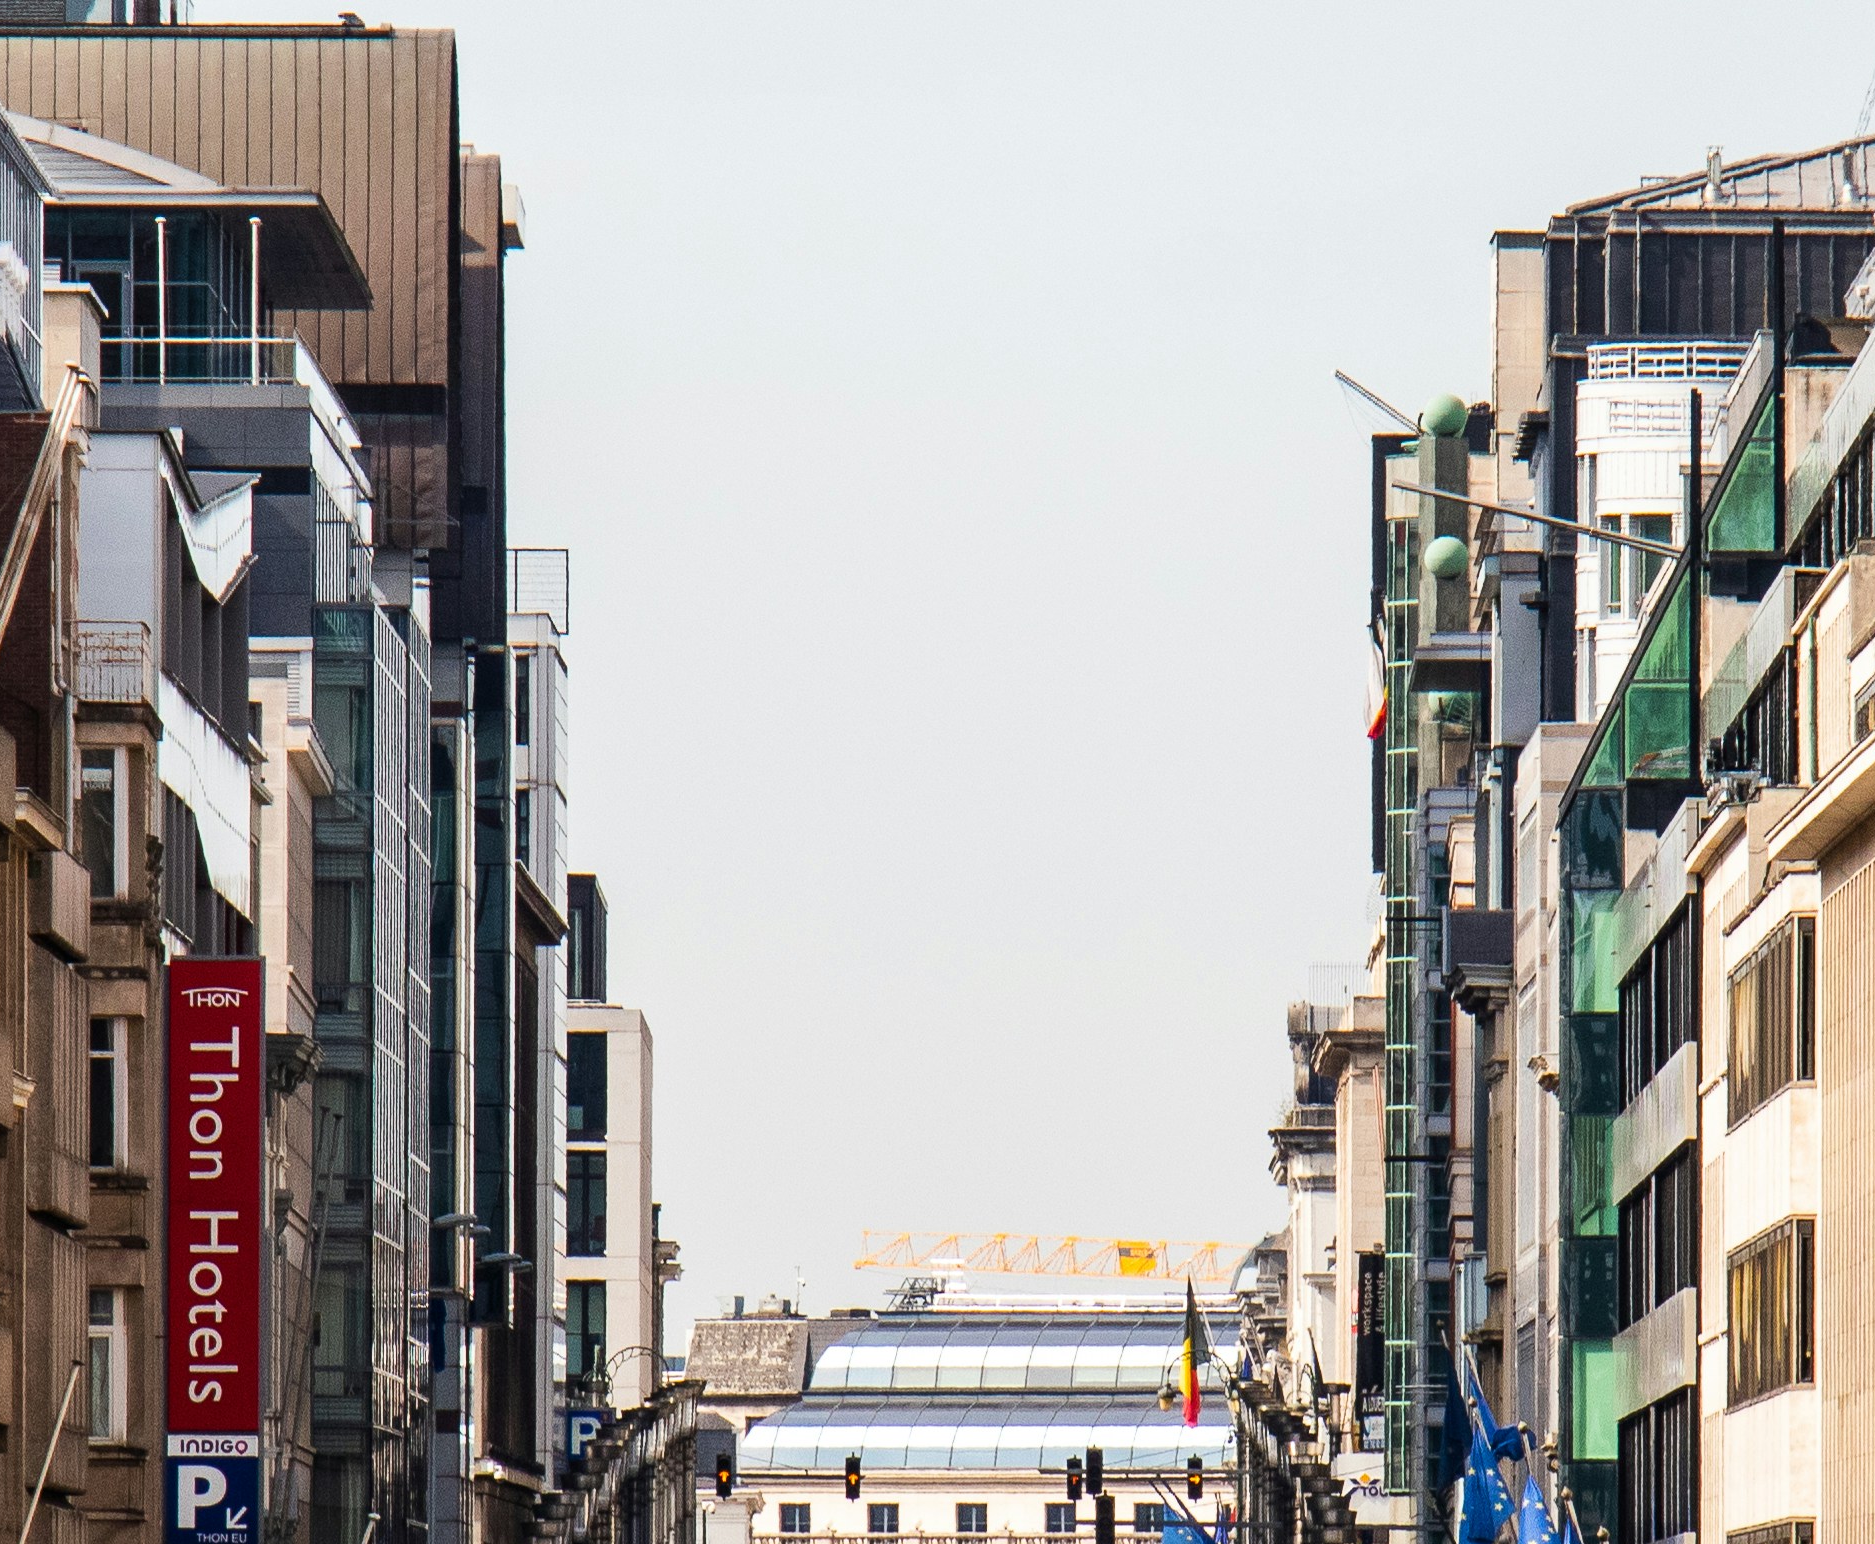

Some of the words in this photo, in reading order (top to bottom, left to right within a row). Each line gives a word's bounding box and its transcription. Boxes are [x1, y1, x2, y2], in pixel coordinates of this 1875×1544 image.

[181, 987, 248, 1007] THON
[189, 1026, 239, 1180] Thon
[188, 1211, 239, 1403] Hotels
[1362, 1272, 1373, 1336] workspace
[180, 1439, 248, 1455] INDIGO
[571, 1416, 602, 1455] P
[177, 1464, 227, 1529] P
[197, 1533, 228, 1544] THON
[232, 1533, 247, 1544] EU
